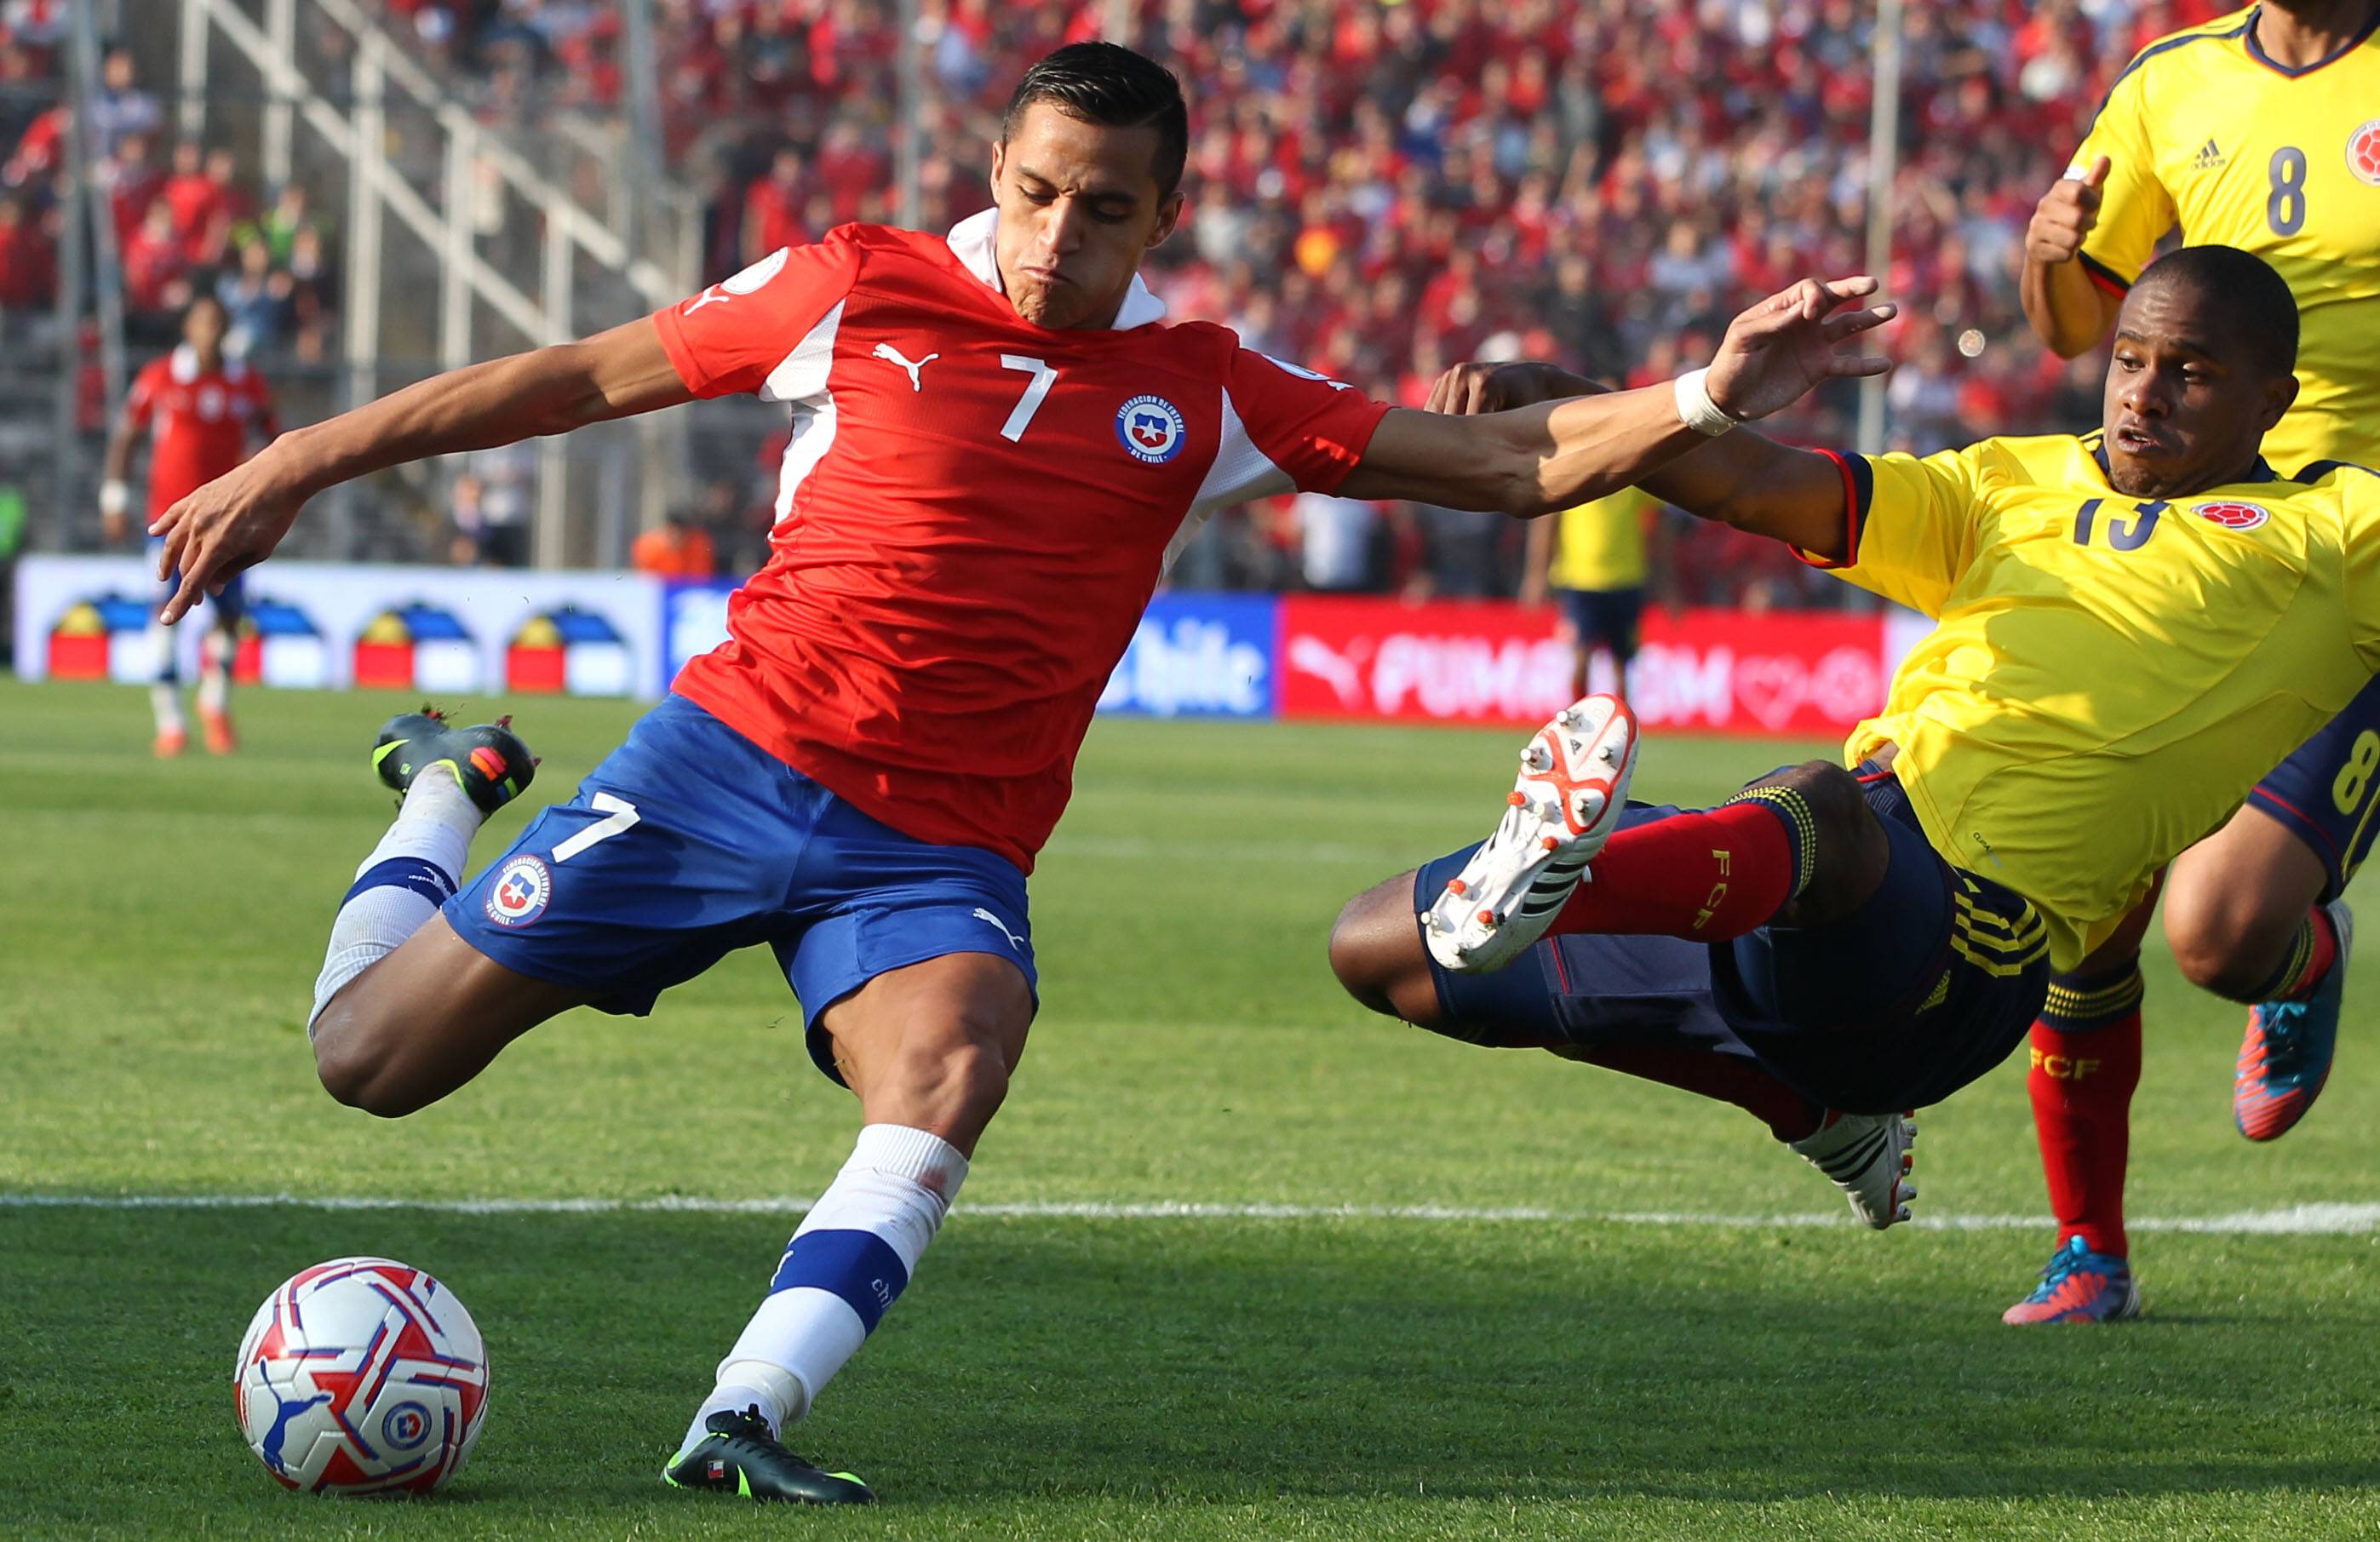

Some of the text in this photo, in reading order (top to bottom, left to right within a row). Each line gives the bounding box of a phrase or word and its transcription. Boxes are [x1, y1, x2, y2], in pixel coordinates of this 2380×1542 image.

[2266, 146, 2307, 237] 8
[1000, 353, 1059, 444] 7
[2073, 498, 2171, 552] 13
[2332, 729, 2380, 816] 8
[550, 791, 641, 863] 7
[1692, 848, 1730, 930] FCF
[2030, 1046, 2102, 1081] FCF
